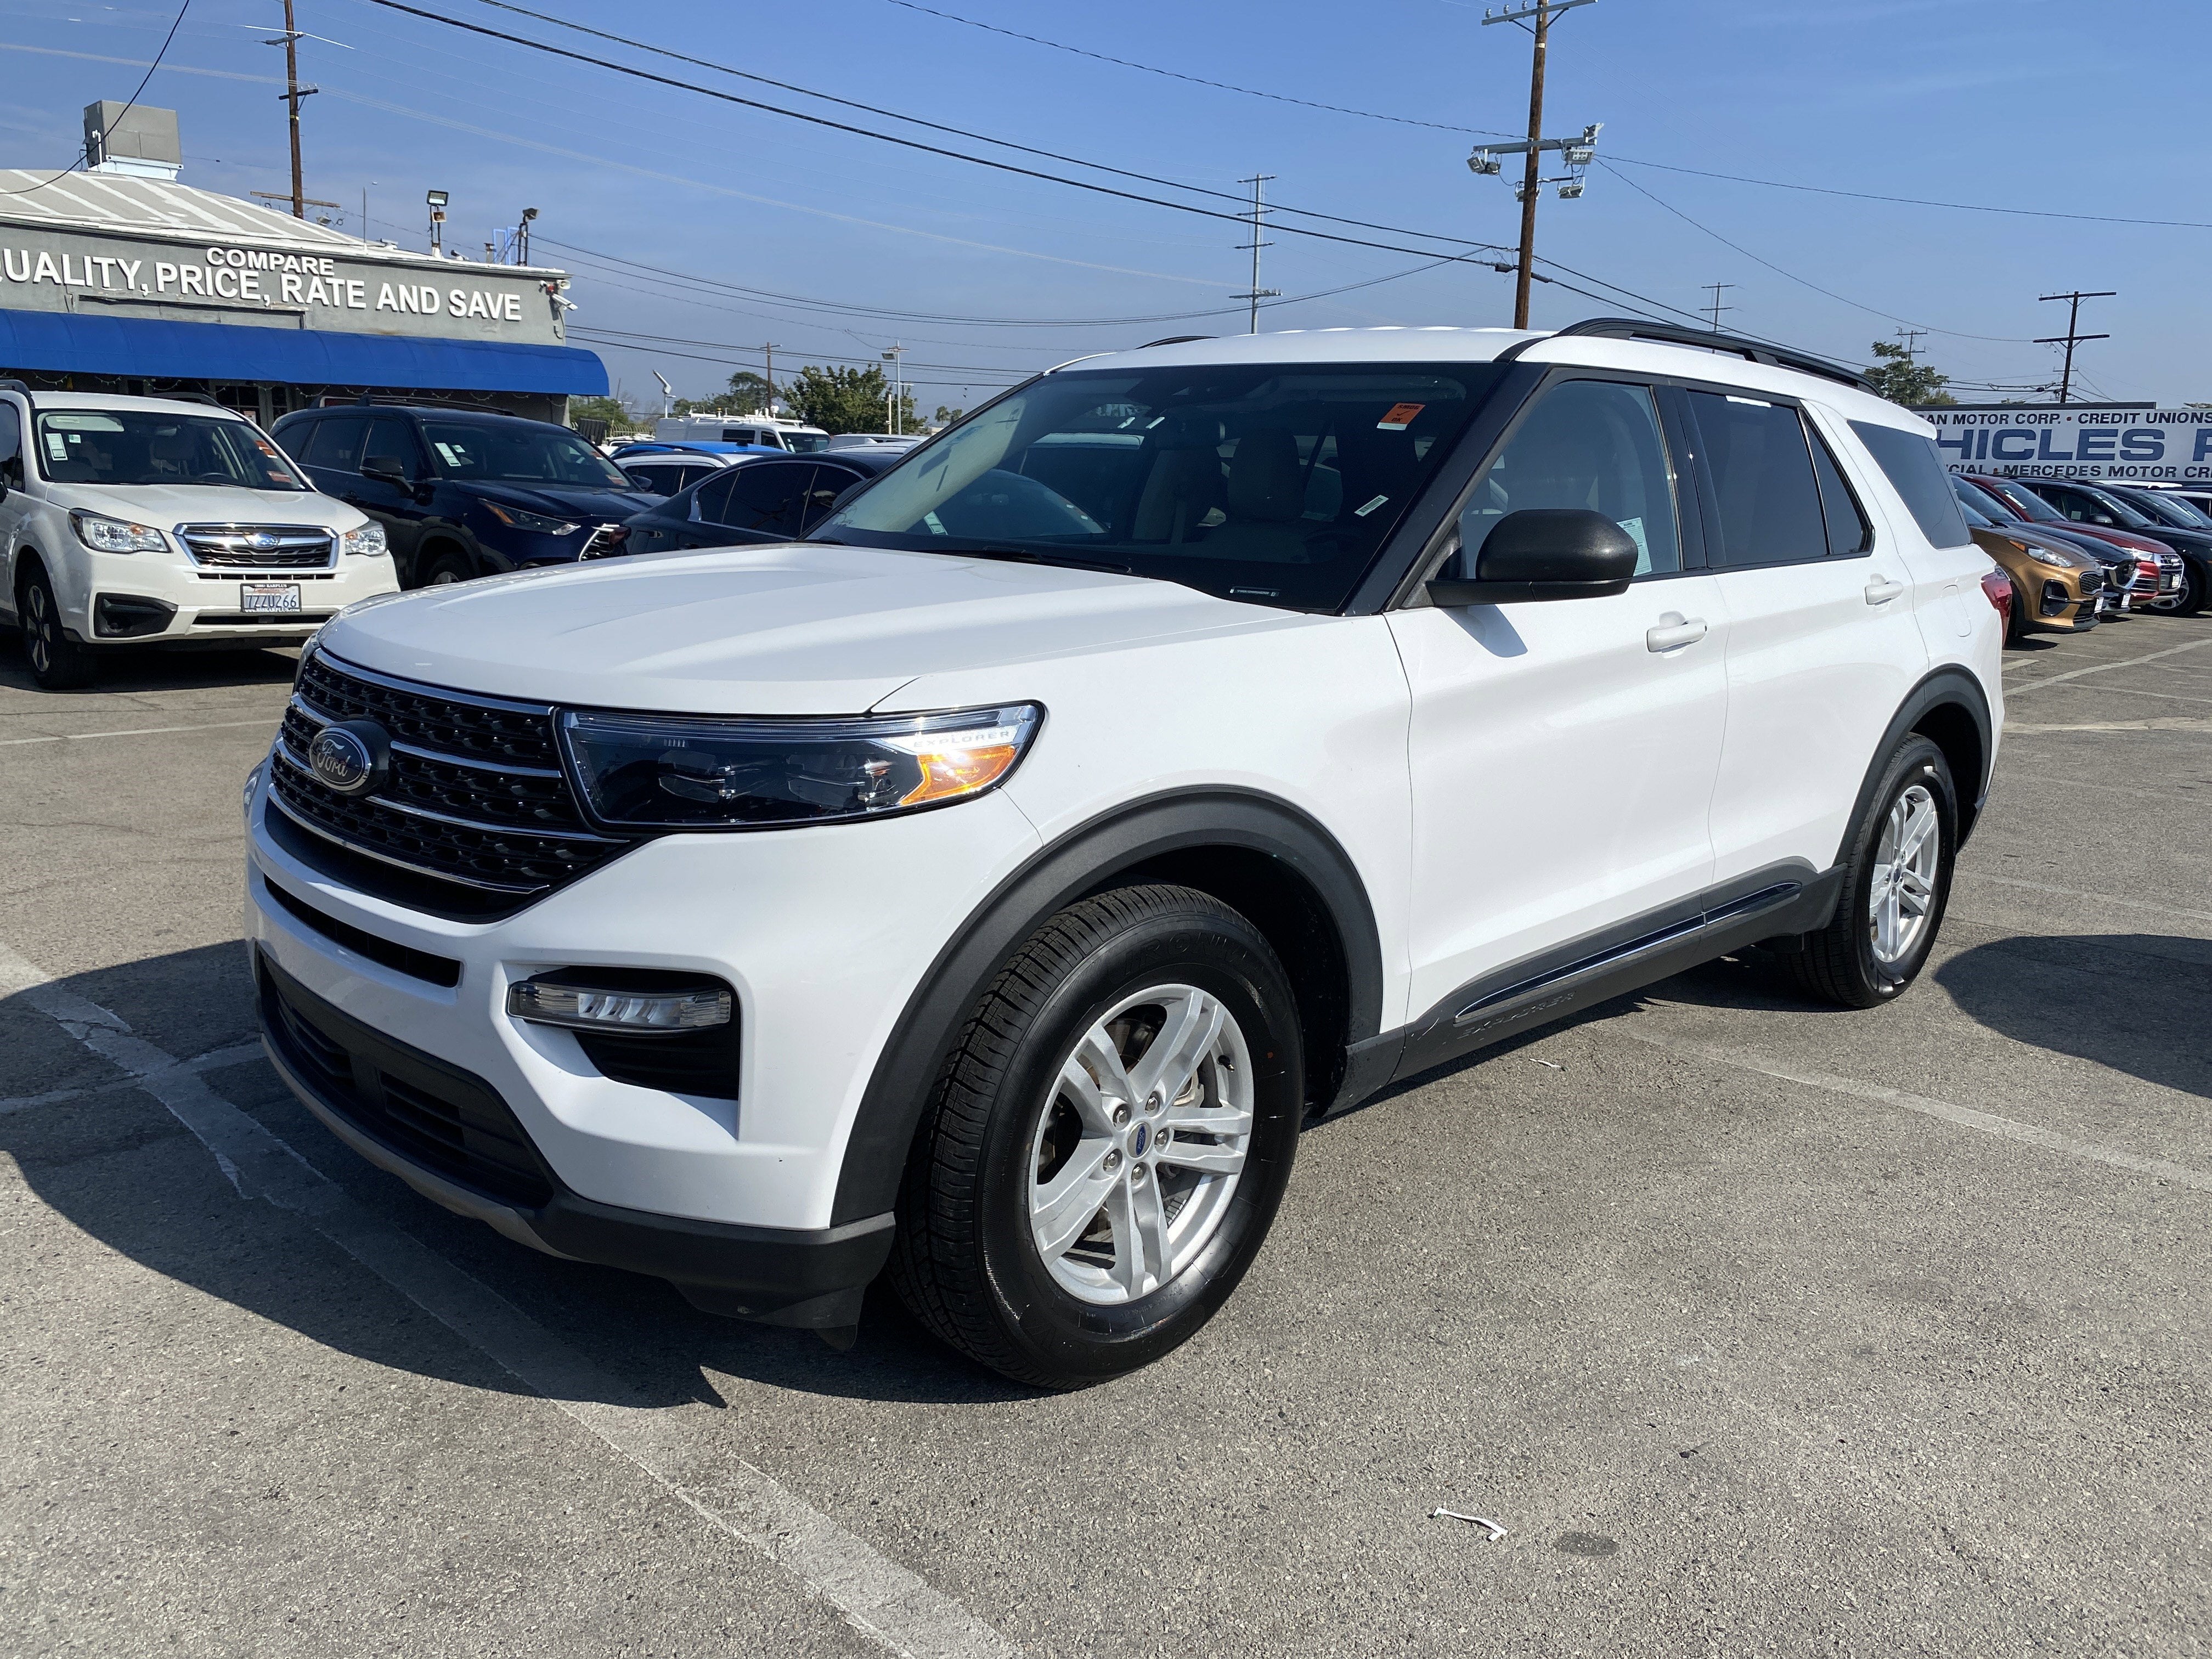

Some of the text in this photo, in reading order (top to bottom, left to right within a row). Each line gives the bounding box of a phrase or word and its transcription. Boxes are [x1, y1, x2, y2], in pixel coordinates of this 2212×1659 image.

[206, 247, 335, 276] COMPARE
[0, 248, 522, 320] UALITY, PRICE, RATE AND SAVE
[1953, 414, 2009, 425] MOTOR
[2015, 413, 2061, 425] CORP.
[2078, 413, 2140, 424] CREDIT
[2146, 412, 2212, 424] UNIONS
[1946, 464, 2212, 478] CIAL MERCEDES MOTOR CR
[245, 594, 297, 608] 7ZZU266
[913, 731, 1010, 748] EXPLORER
[317, 738, 351, 777] Ford
[1456, 991, 1577, 1040] EXPLORER
